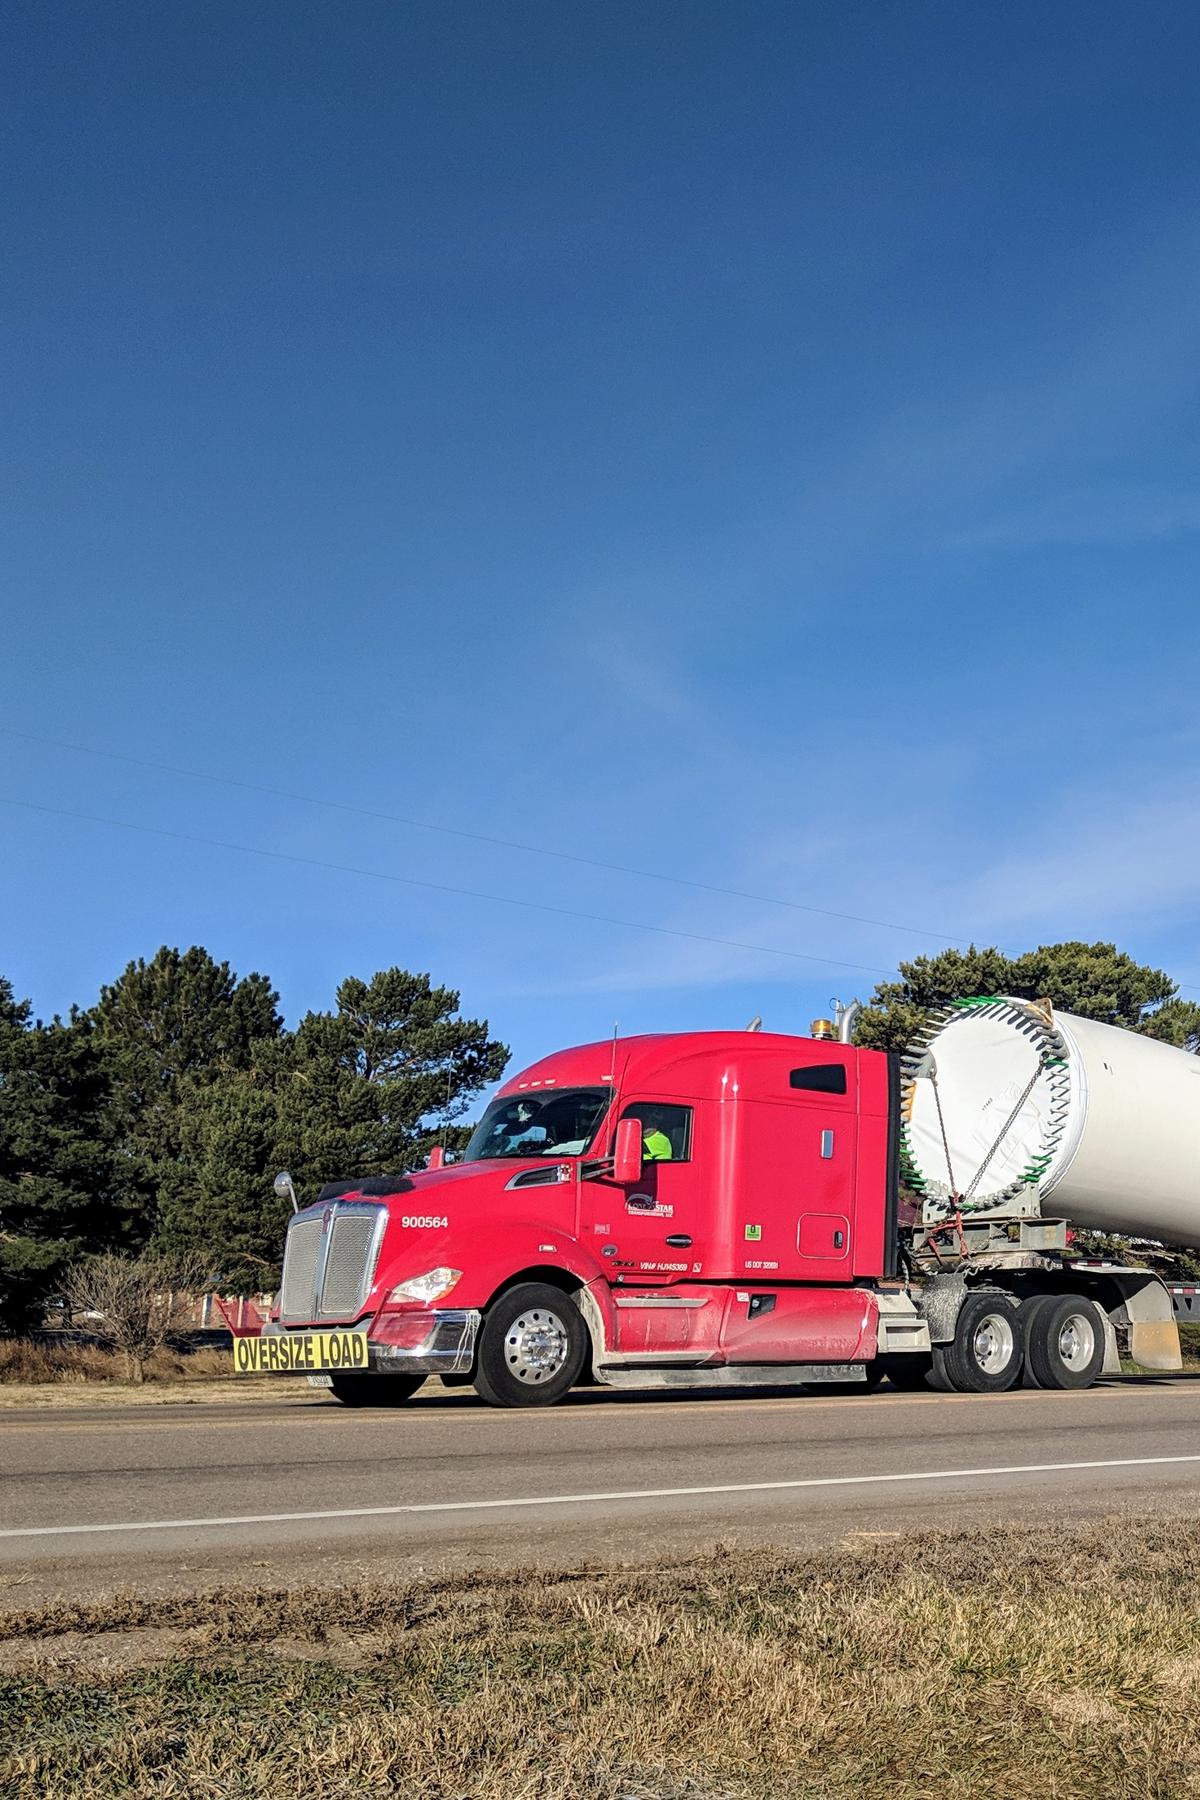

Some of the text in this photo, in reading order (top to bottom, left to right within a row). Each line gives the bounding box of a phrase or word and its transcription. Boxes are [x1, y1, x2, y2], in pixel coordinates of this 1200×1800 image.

[655, 1204, 674, 1212] STAR
[401, 1216, 449, 1228] 900564
[640, 1262, 656, 1270] VIN#
[237, 1333, 364, 1370] OVERSIZE LOAD
